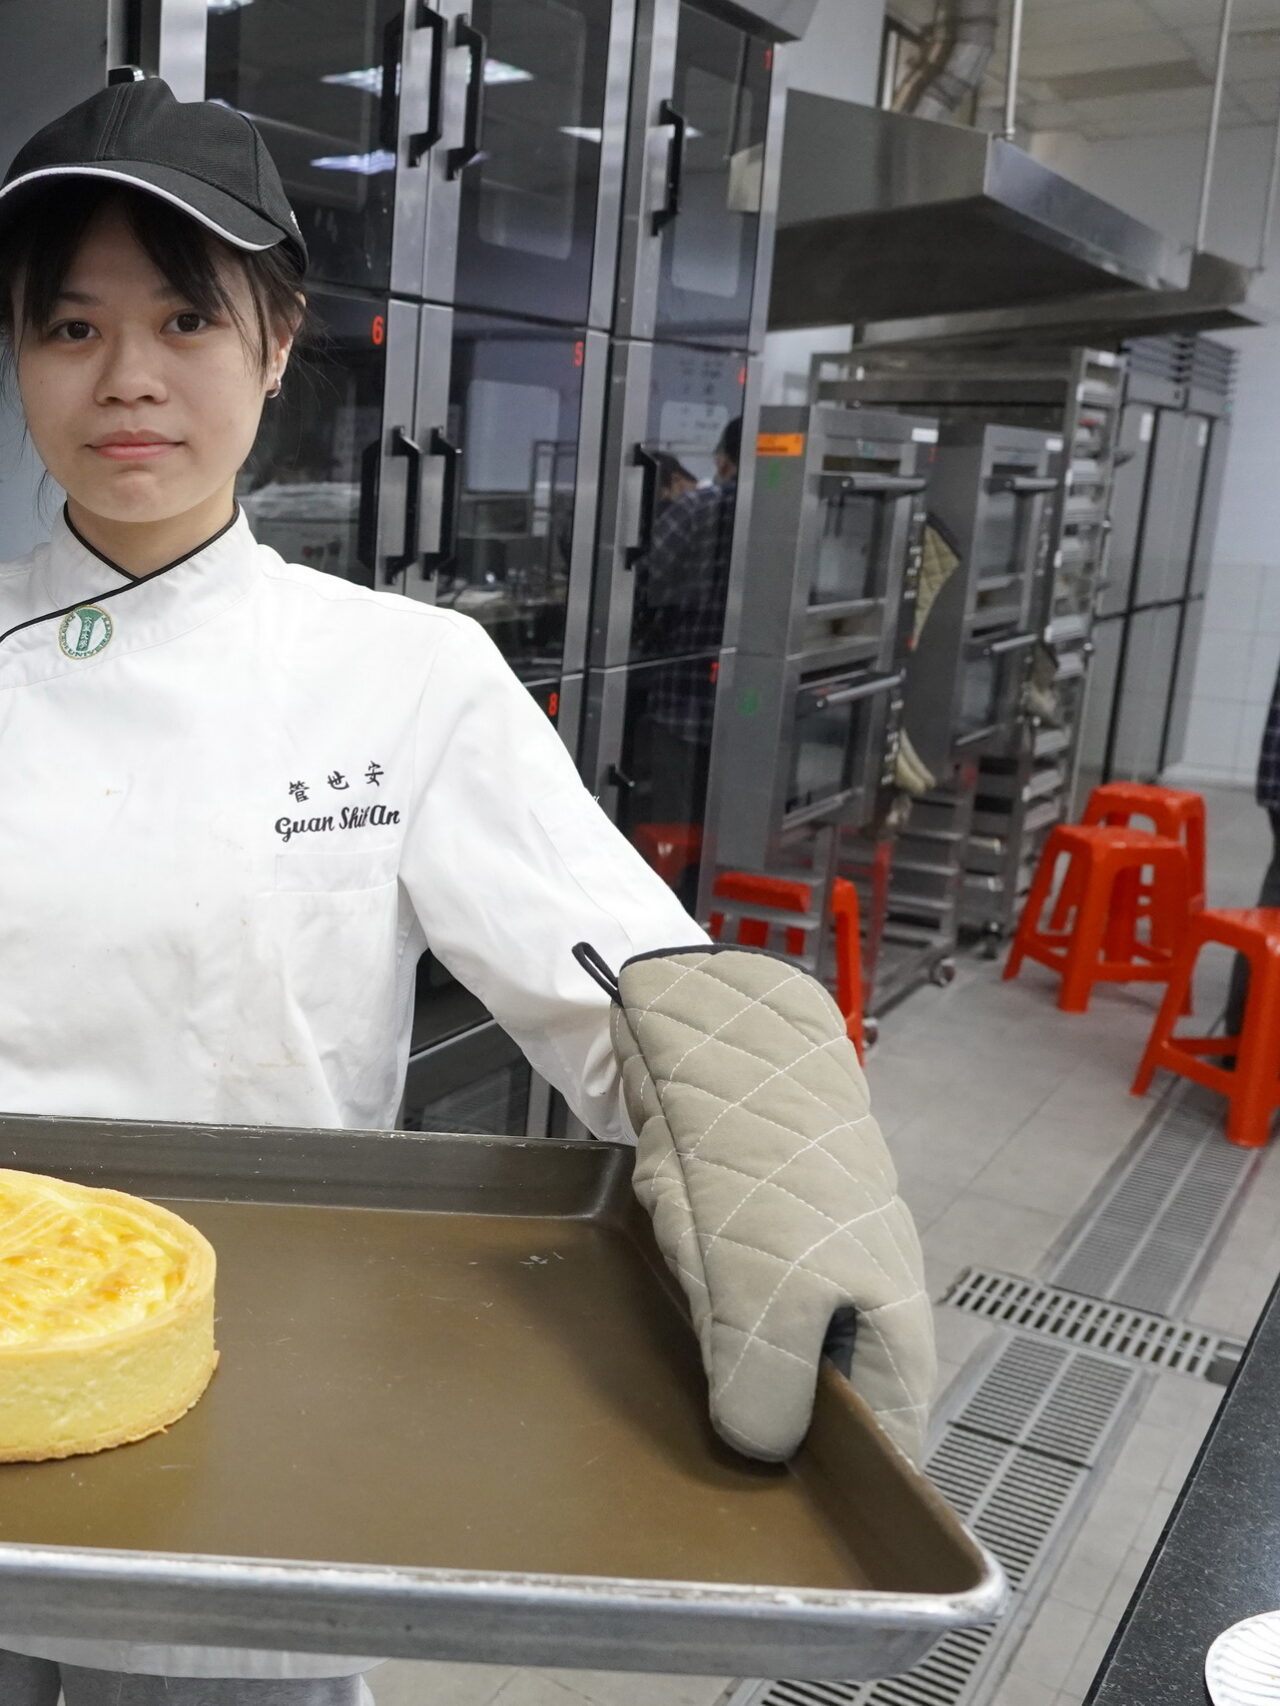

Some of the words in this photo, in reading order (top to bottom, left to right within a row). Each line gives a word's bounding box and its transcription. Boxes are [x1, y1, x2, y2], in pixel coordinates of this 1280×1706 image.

[371, 315, 384, 344] 6
[574, 341, 583, 367] 5
[547, 693, 559, 717] 8
[274, 816, 334, 843] Guan
